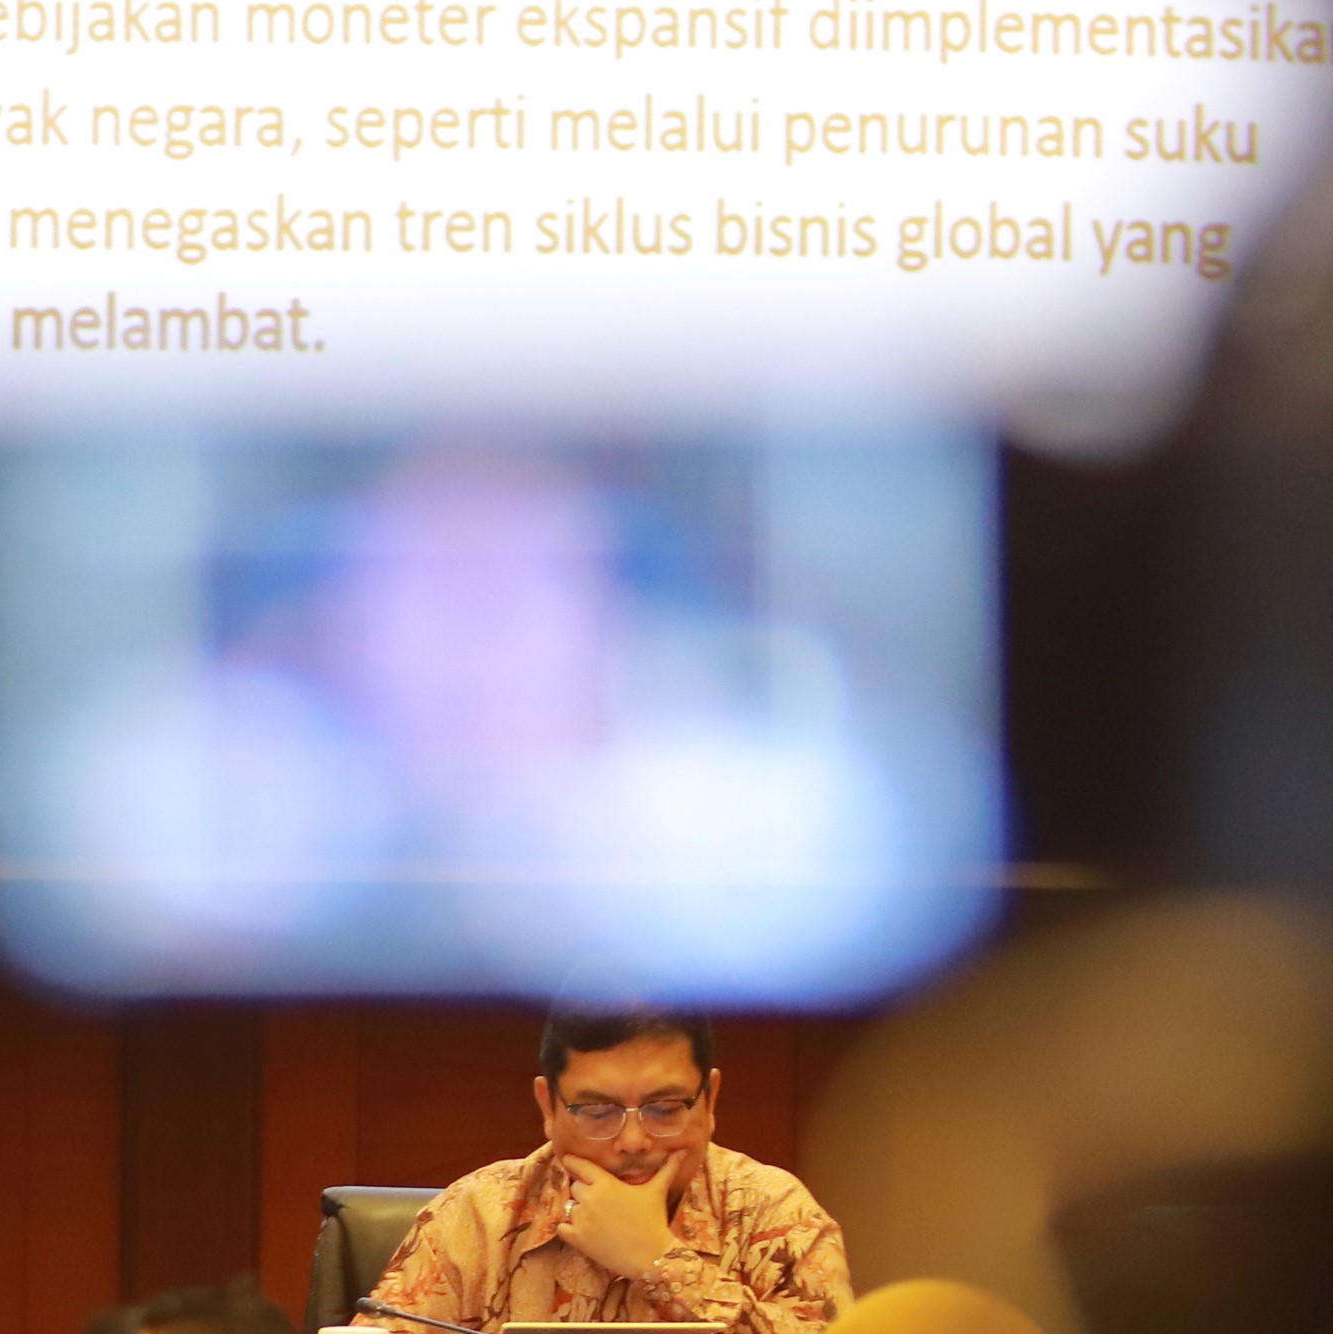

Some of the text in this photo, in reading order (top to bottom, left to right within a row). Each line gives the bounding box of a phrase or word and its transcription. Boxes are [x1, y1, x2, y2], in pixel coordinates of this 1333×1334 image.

[246, 0, 498, 47] moneter
[516, 0, 790, 61] ekspansif
[809, 0, 1333, 65] diimplementasika
[91, 104, 303, 161] negara,
[326, 94, 526, 162] seperti
[550, 93, 761, 154] melalui
[784, 111, 1104, 167] penurunan
[1124, 103, 1259, 166] suku
[9, 192, 373, 267] menegaskan
[395, 201, 513, 254] tren
[535, 196, 694, 257] siklus
[715, 197, 879, 260] bisnis
[896, 200, 1073, 274] global
[1092, 219, 1231, 281] yang
[11, 290, 325, 353] melambat.
